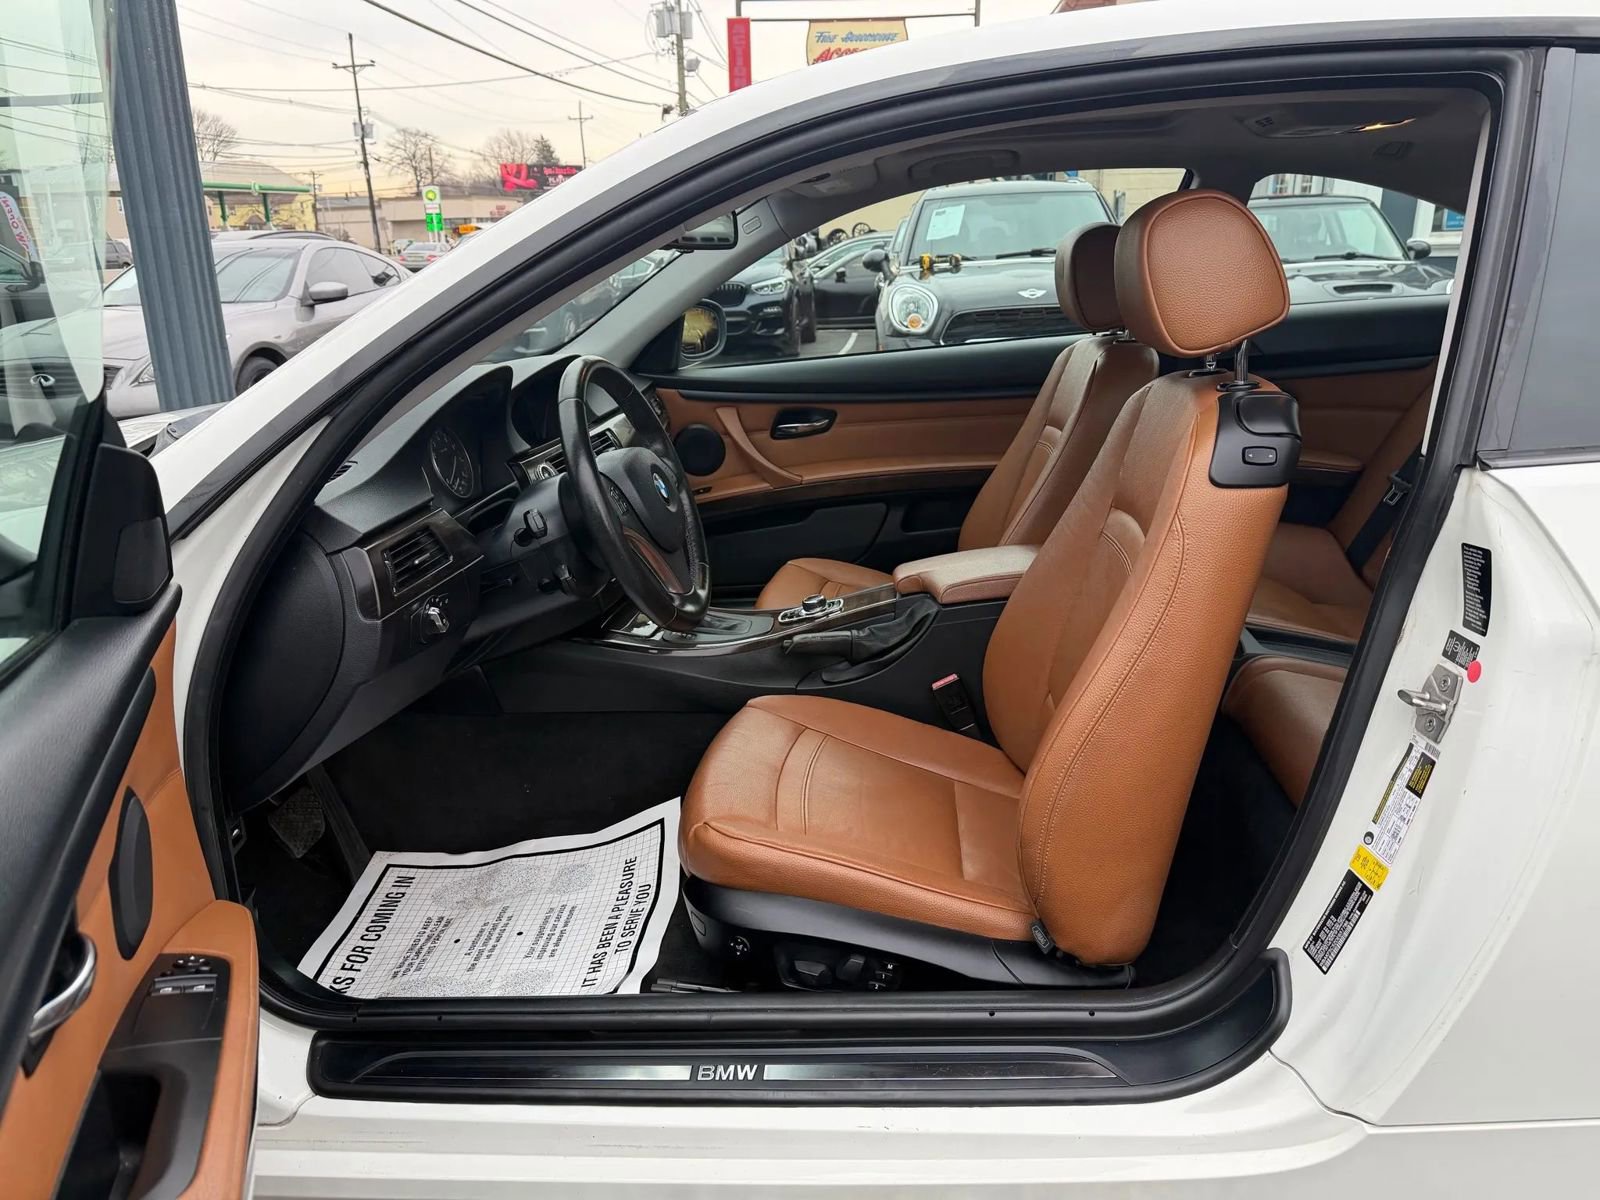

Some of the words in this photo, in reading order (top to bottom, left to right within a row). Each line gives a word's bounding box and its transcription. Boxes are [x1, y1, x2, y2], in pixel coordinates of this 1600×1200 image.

[611, 856, 638, 913] PLEASURE
[634, 883, 652, 907] YOU
[340, 945, 375, 972] FOR
[360, 892, 407, 941] COMING
[392, 876, 416, 888] IN
[421, 916, 433, 930] KEEP
[482, 922, 500, 947] important
[620, 907, 645, 937] SERVE
[468, 928, 486, 951] customer
[523, 946, 536, 960] Your
[532, 914, 552, 946] suggestions
[537, 932, 555, 960] improving
[553, 928, 567, 948] always
[596, 922, 619, 950] BEEN
[614, 940, 632, 955] TO
[587, 951, 608, 976] HAS
[581, 978, 599, 988] IT
[697, 1064, 758, 1081] BMW
